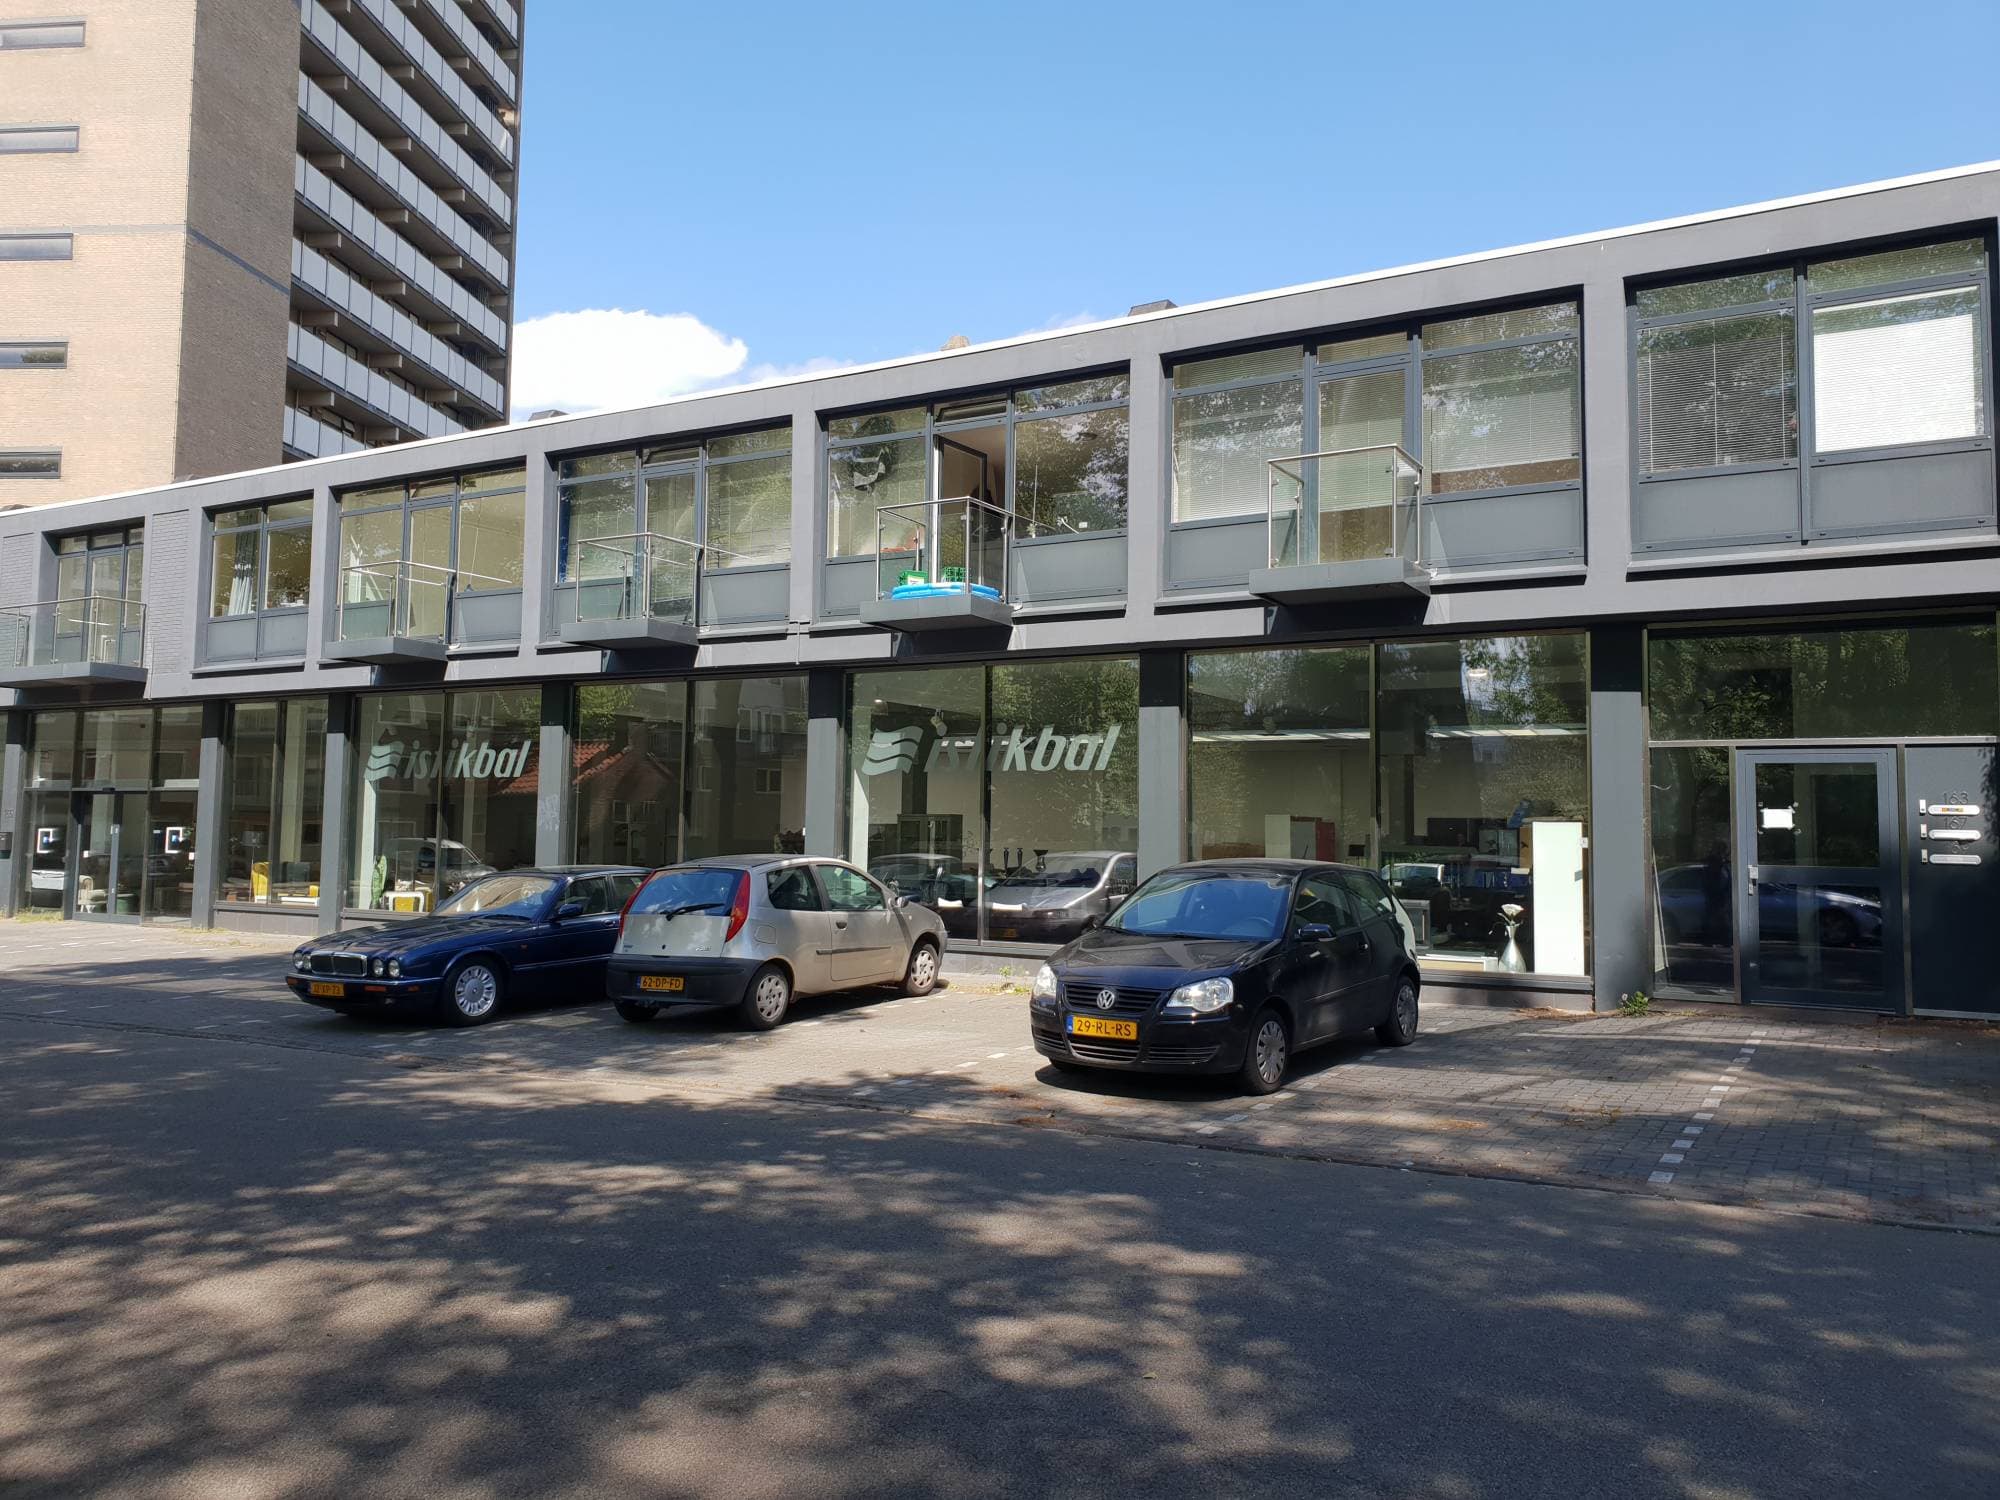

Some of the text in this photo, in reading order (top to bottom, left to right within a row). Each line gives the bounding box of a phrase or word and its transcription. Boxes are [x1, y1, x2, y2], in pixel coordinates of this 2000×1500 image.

[1943, 790, 1969, 804] 163
[642, 977, 681, 989] 62-DP-FD
[1076, 1020, 1131, 1037] 29-RL-RS
